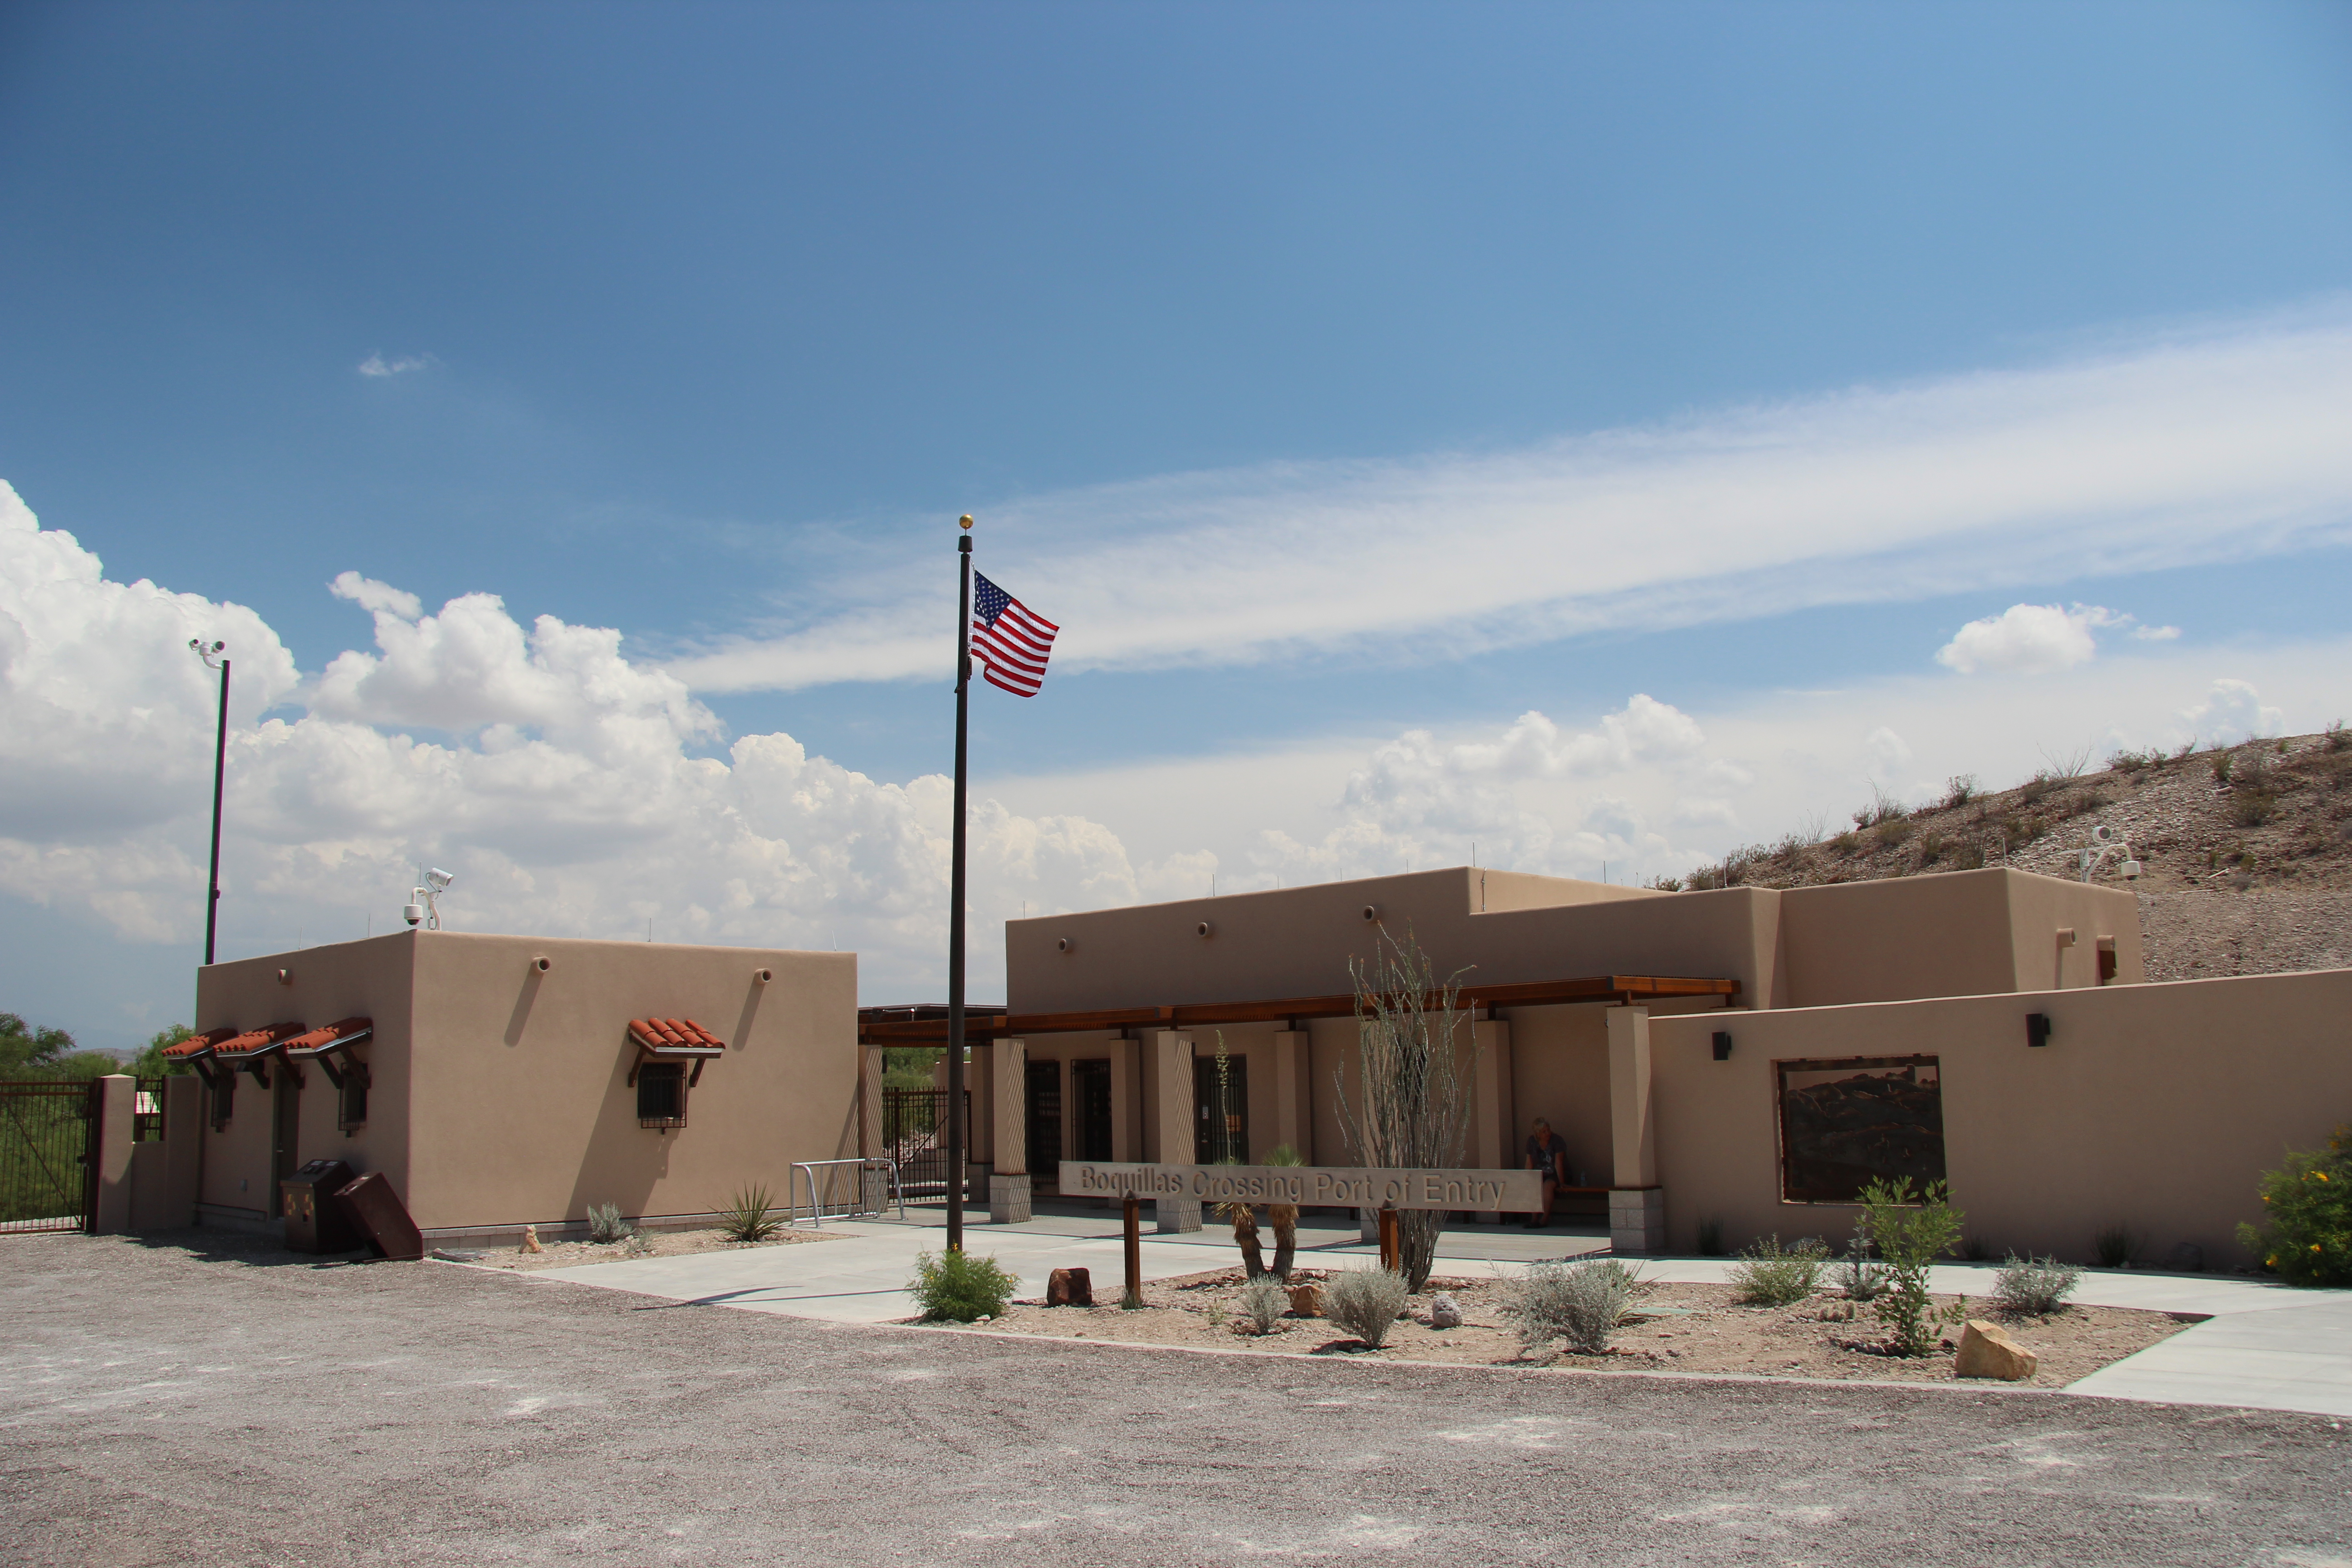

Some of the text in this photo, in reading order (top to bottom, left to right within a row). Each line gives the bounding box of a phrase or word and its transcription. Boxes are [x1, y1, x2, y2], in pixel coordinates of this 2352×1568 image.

[1081, 1166, 1507, 1210] Boquillas Crossing Port of Entry
